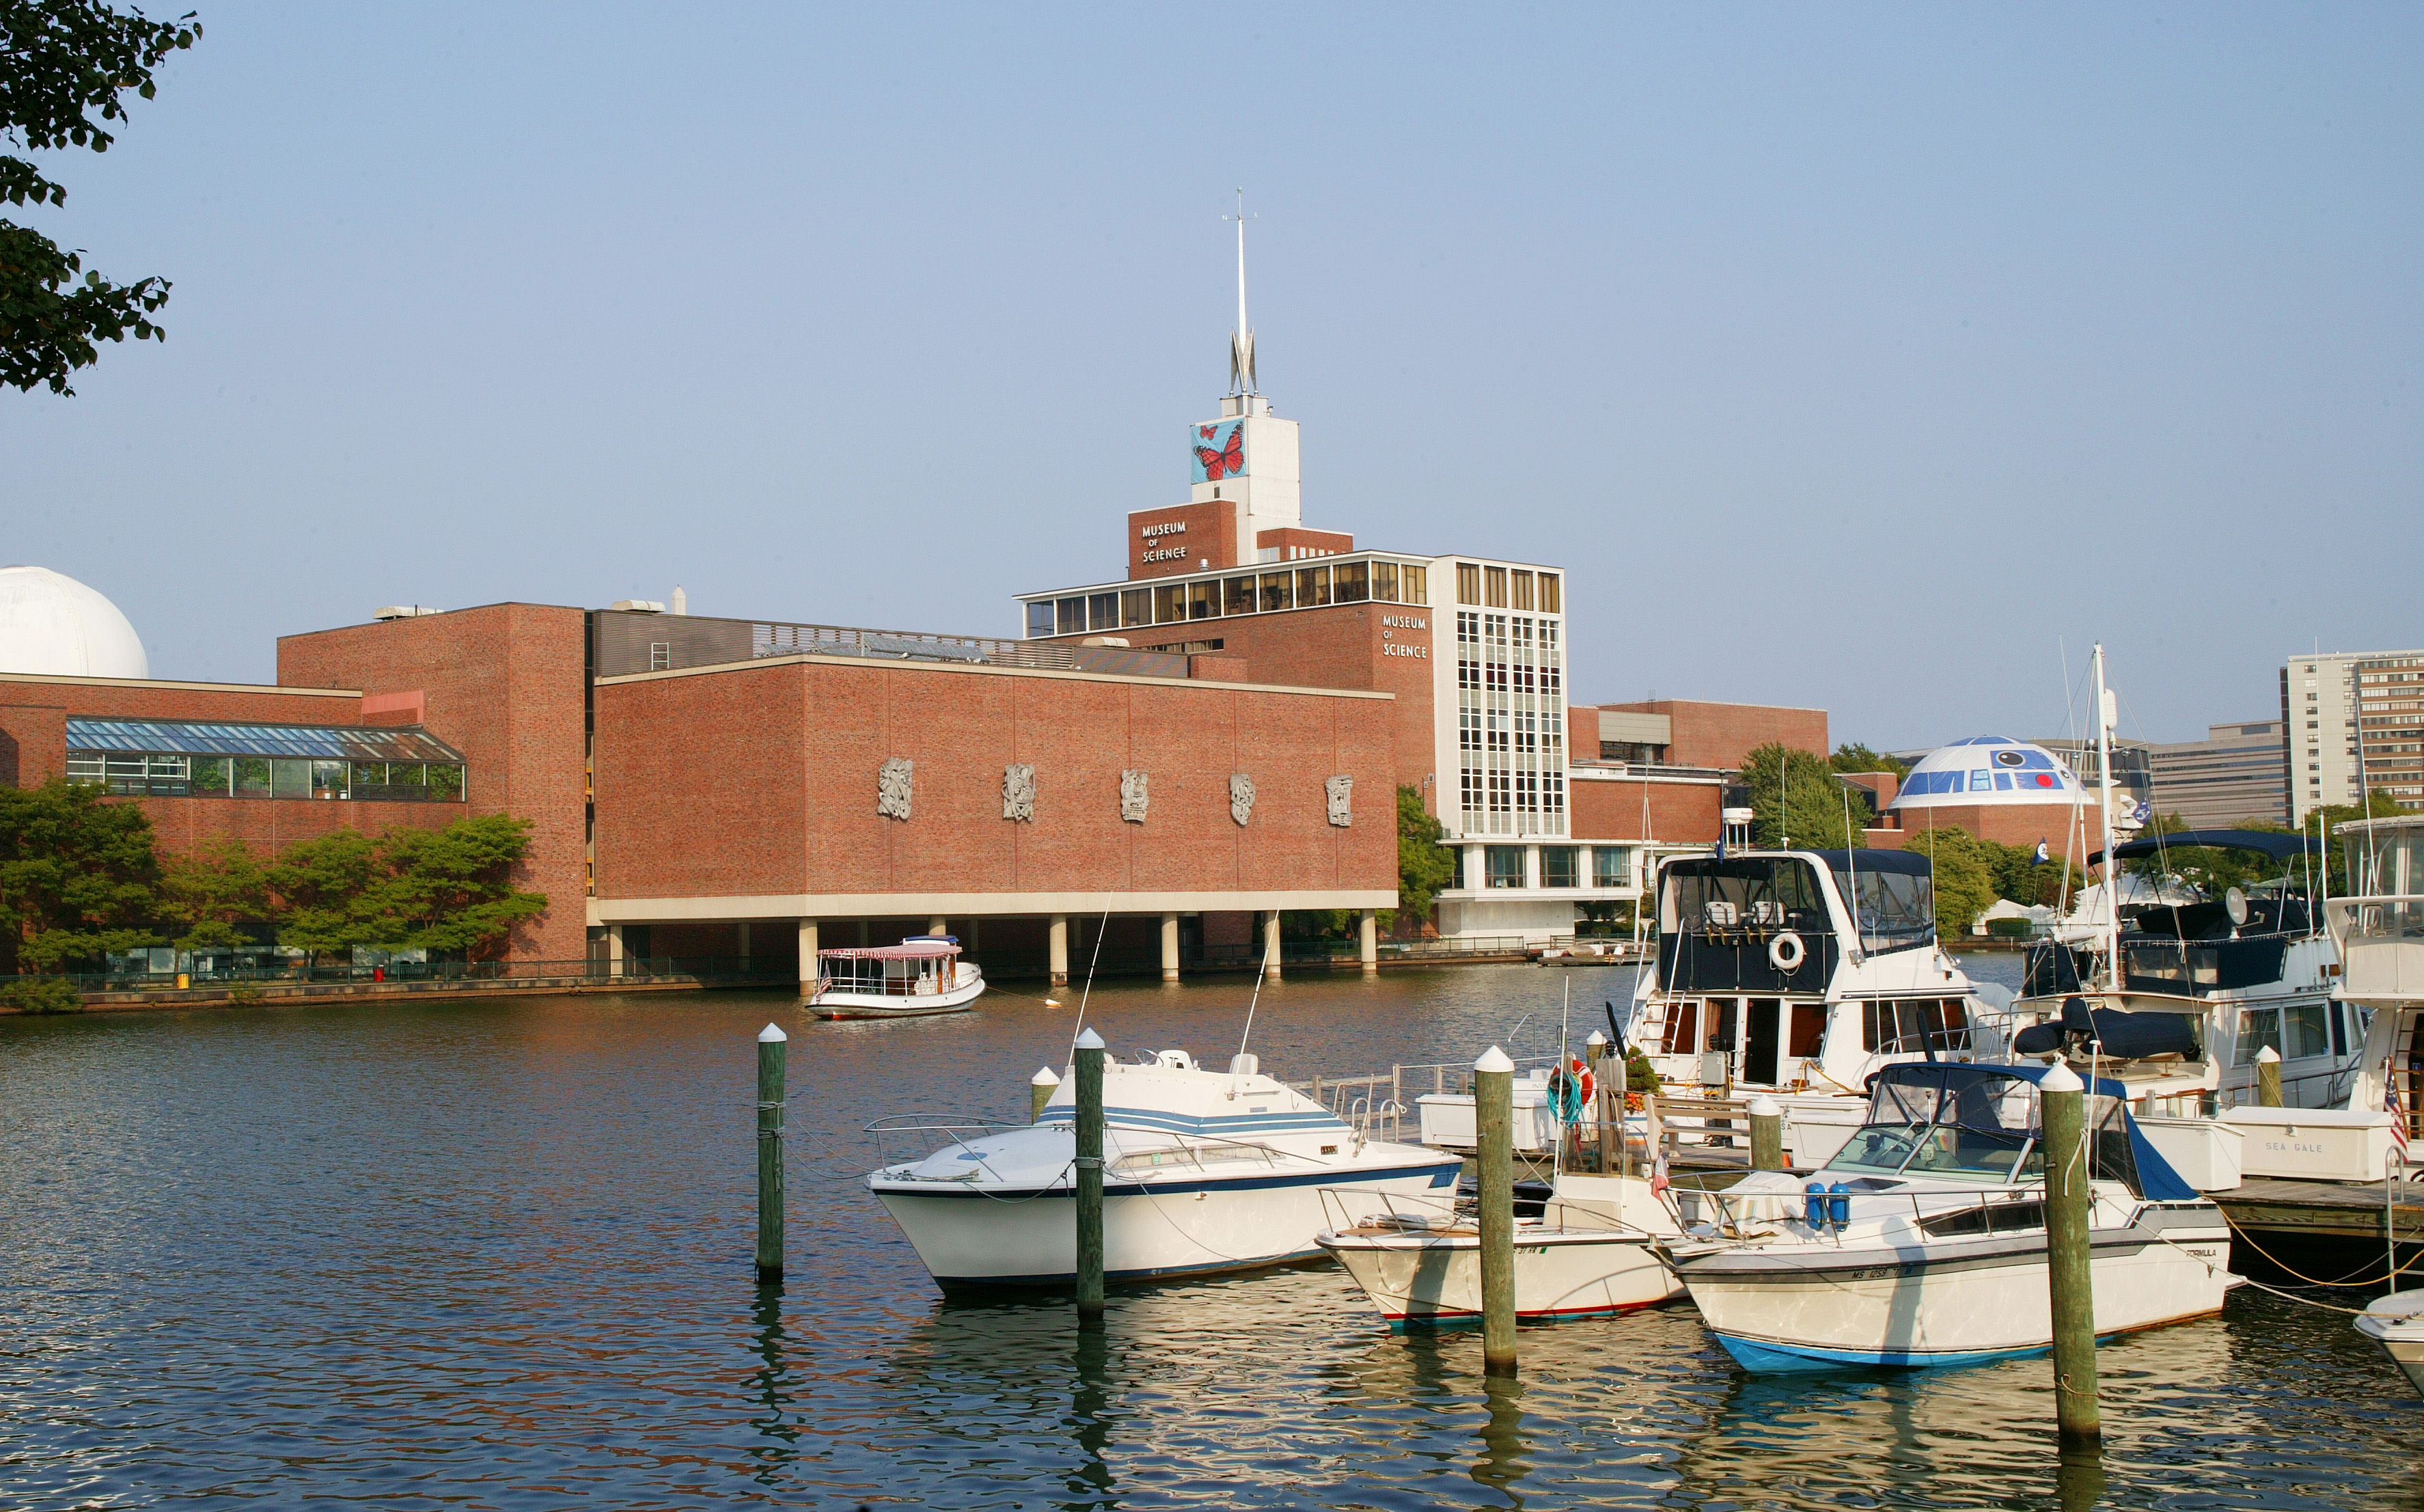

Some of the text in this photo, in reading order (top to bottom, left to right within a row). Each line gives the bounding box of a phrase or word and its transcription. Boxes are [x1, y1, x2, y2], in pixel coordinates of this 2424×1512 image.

[1142, 521, 1186, 538] MUSEUM
[1143, 547, 1186, 562] SCIENCE
[1383, 615, 1425, 629] MUSEUM
[1383, 631, 1392, 639] OF
[1383, 644, 1426, 658] SCIENCE
[2265, 1142, 2322, 1153] SEA GALE
